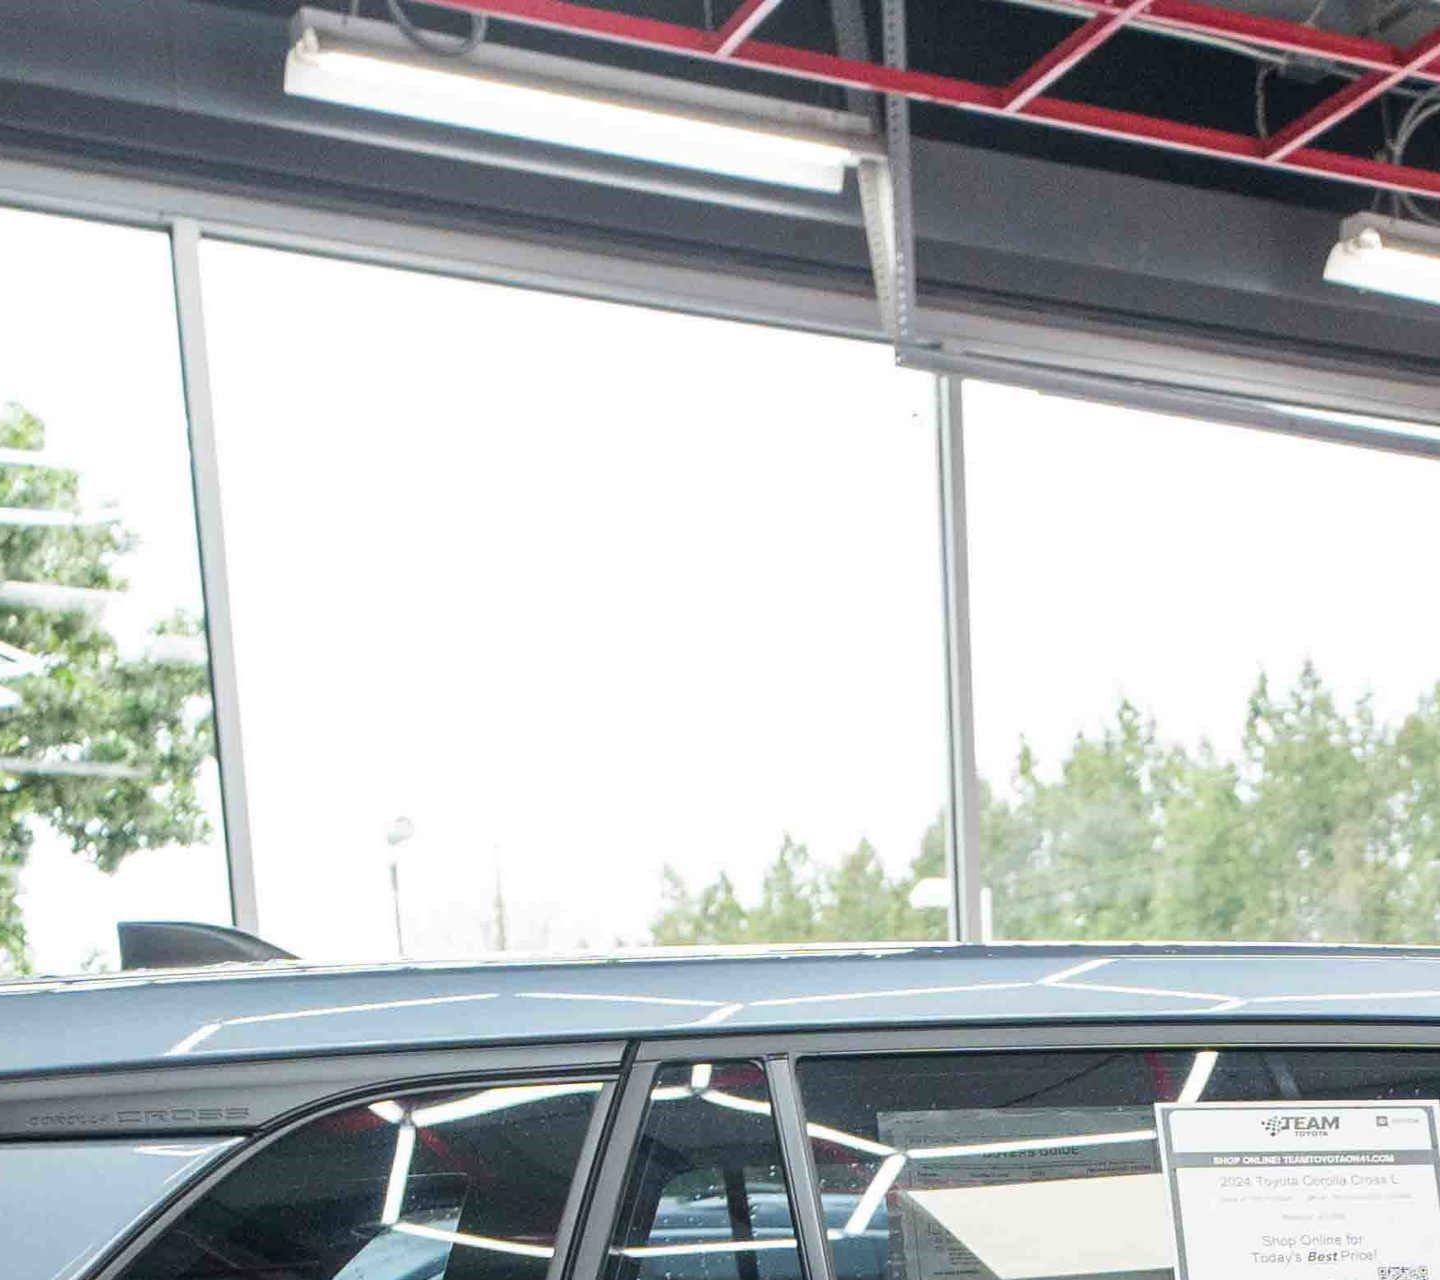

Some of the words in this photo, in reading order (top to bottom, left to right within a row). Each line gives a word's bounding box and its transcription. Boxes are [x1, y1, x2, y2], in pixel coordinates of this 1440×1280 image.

[116, 1107, 250, 1124] CROSS
[1280, 1115, 1340, 1131] TEAM
[1213, 1156, 1241, 1165] SHOP
[1242, 1155, 1280, 1165] ONLINE!
[1220, 1176, 1252, 1188] 2024
[1257, 1175, 1299, 1189] Toyota
[1302, 1174, 1347, 1187] Corolla
[1350, 1174, 1390, 1186] Cross
[1261, 1234, 1296, 1249] Shop
[1299, 1233, 1343, 1247] Online
[1346, 1233, 1364, 1246] for
[1252, 1251, 1303, 1265] Today's
[1308, 1250, 1339, 1263] Best
[1341, 1249, 1378, 1262] Price!
